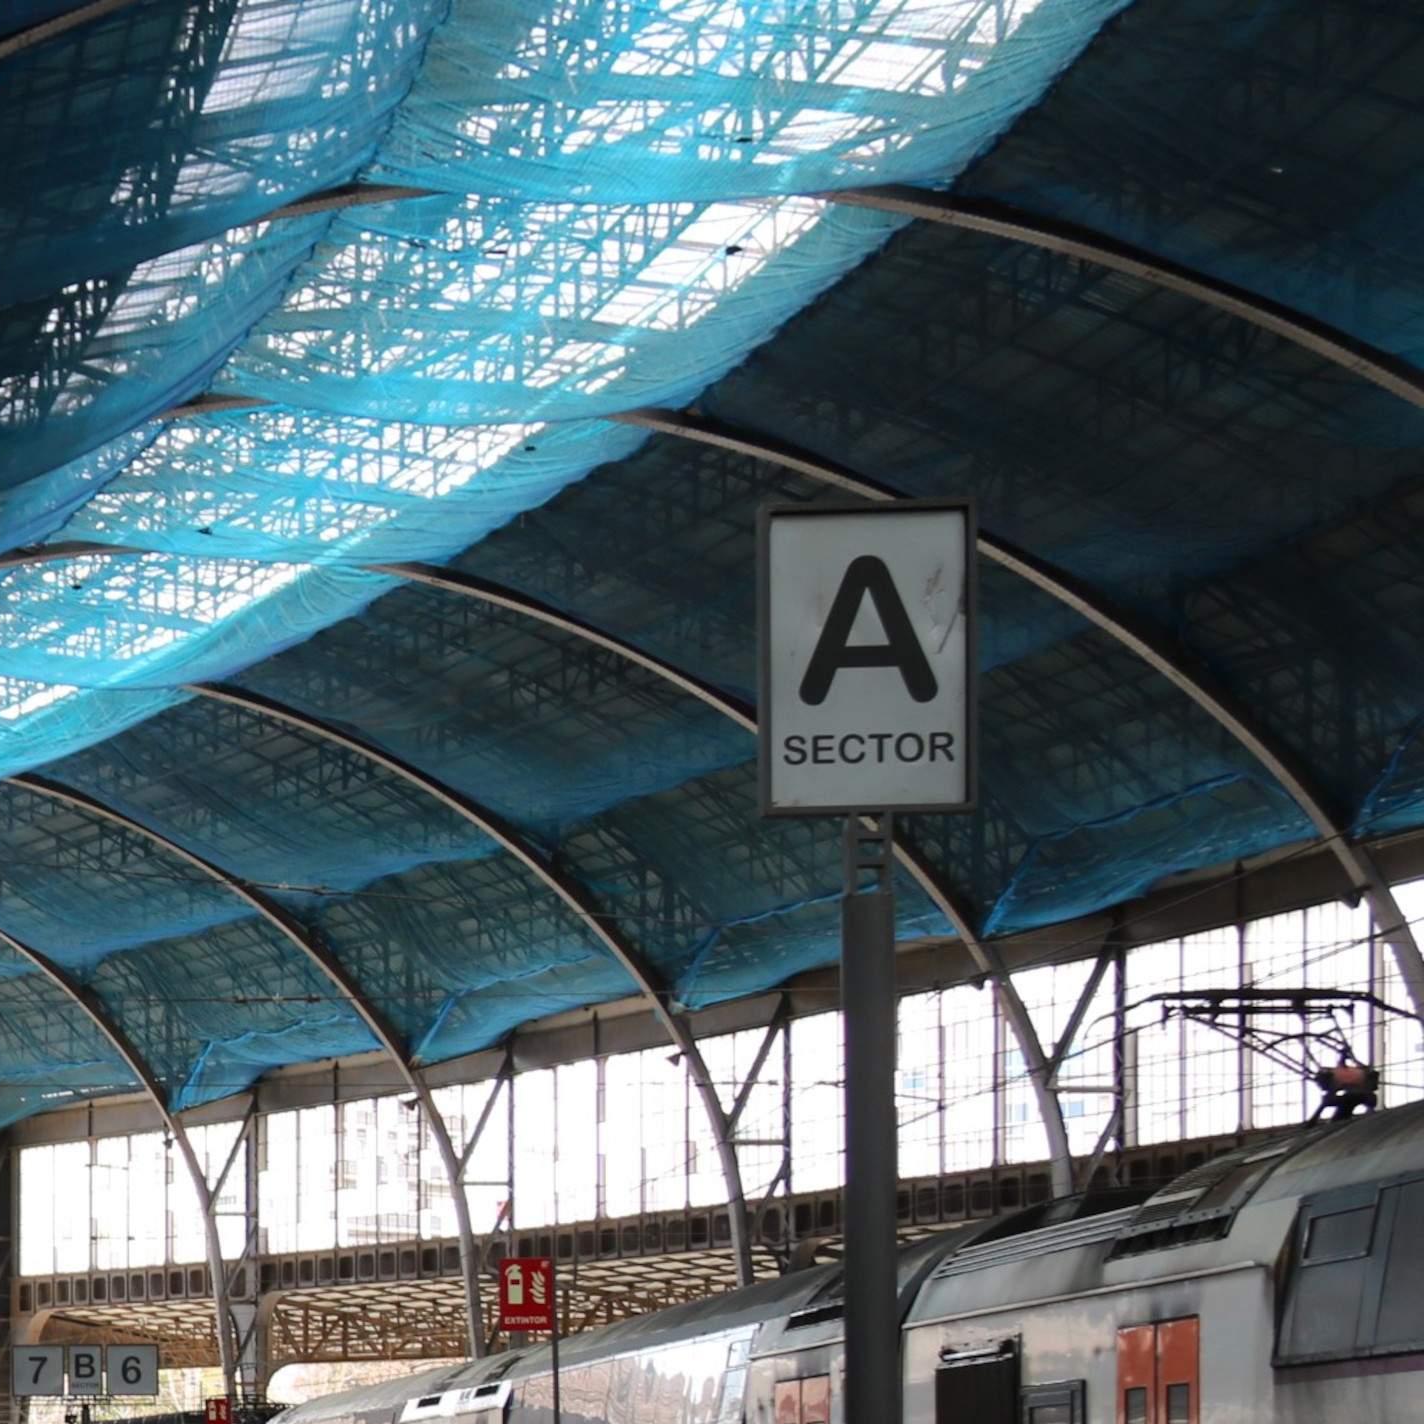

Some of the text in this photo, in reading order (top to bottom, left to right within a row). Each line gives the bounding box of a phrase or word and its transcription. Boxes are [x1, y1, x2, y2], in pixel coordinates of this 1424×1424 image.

[798, 554, 939, 706] A
[783, 731, 955, 765] SECTOR
[28, 1353, 142, 1385] 7 B 6
